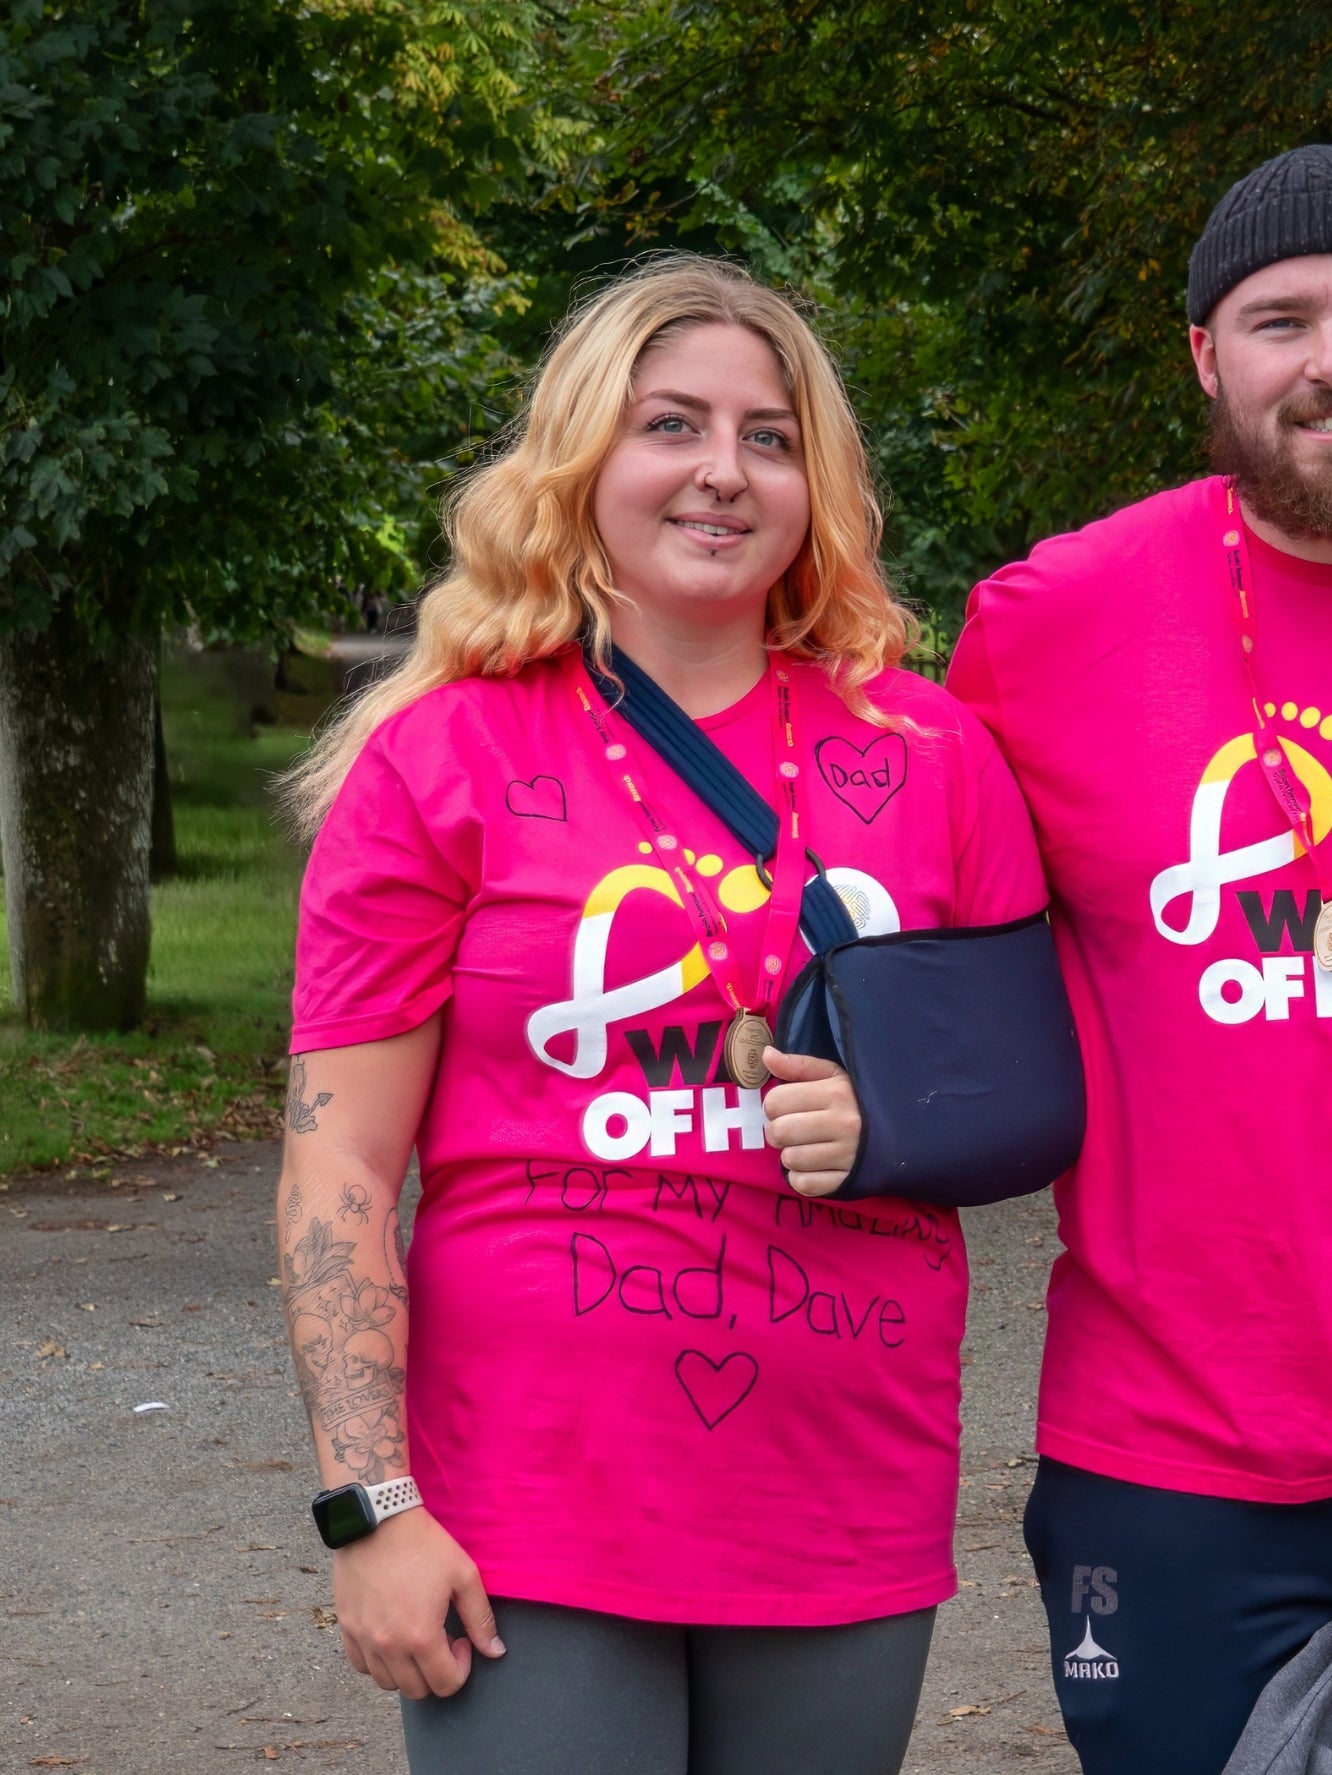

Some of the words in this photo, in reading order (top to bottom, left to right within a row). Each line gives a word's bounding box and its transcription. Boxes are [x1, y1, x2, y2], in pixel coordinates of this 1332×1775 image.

[829, 757, 891, 789] Dad
[1198, 958, 1305, 1024] OF
[581, 1089, 695, 1161] OF
[767, 1244, 907, 1348] Dave
[1071, 1565, 1119, 1615] FS
[1064, 1661, 1120, 1679] MAKO
